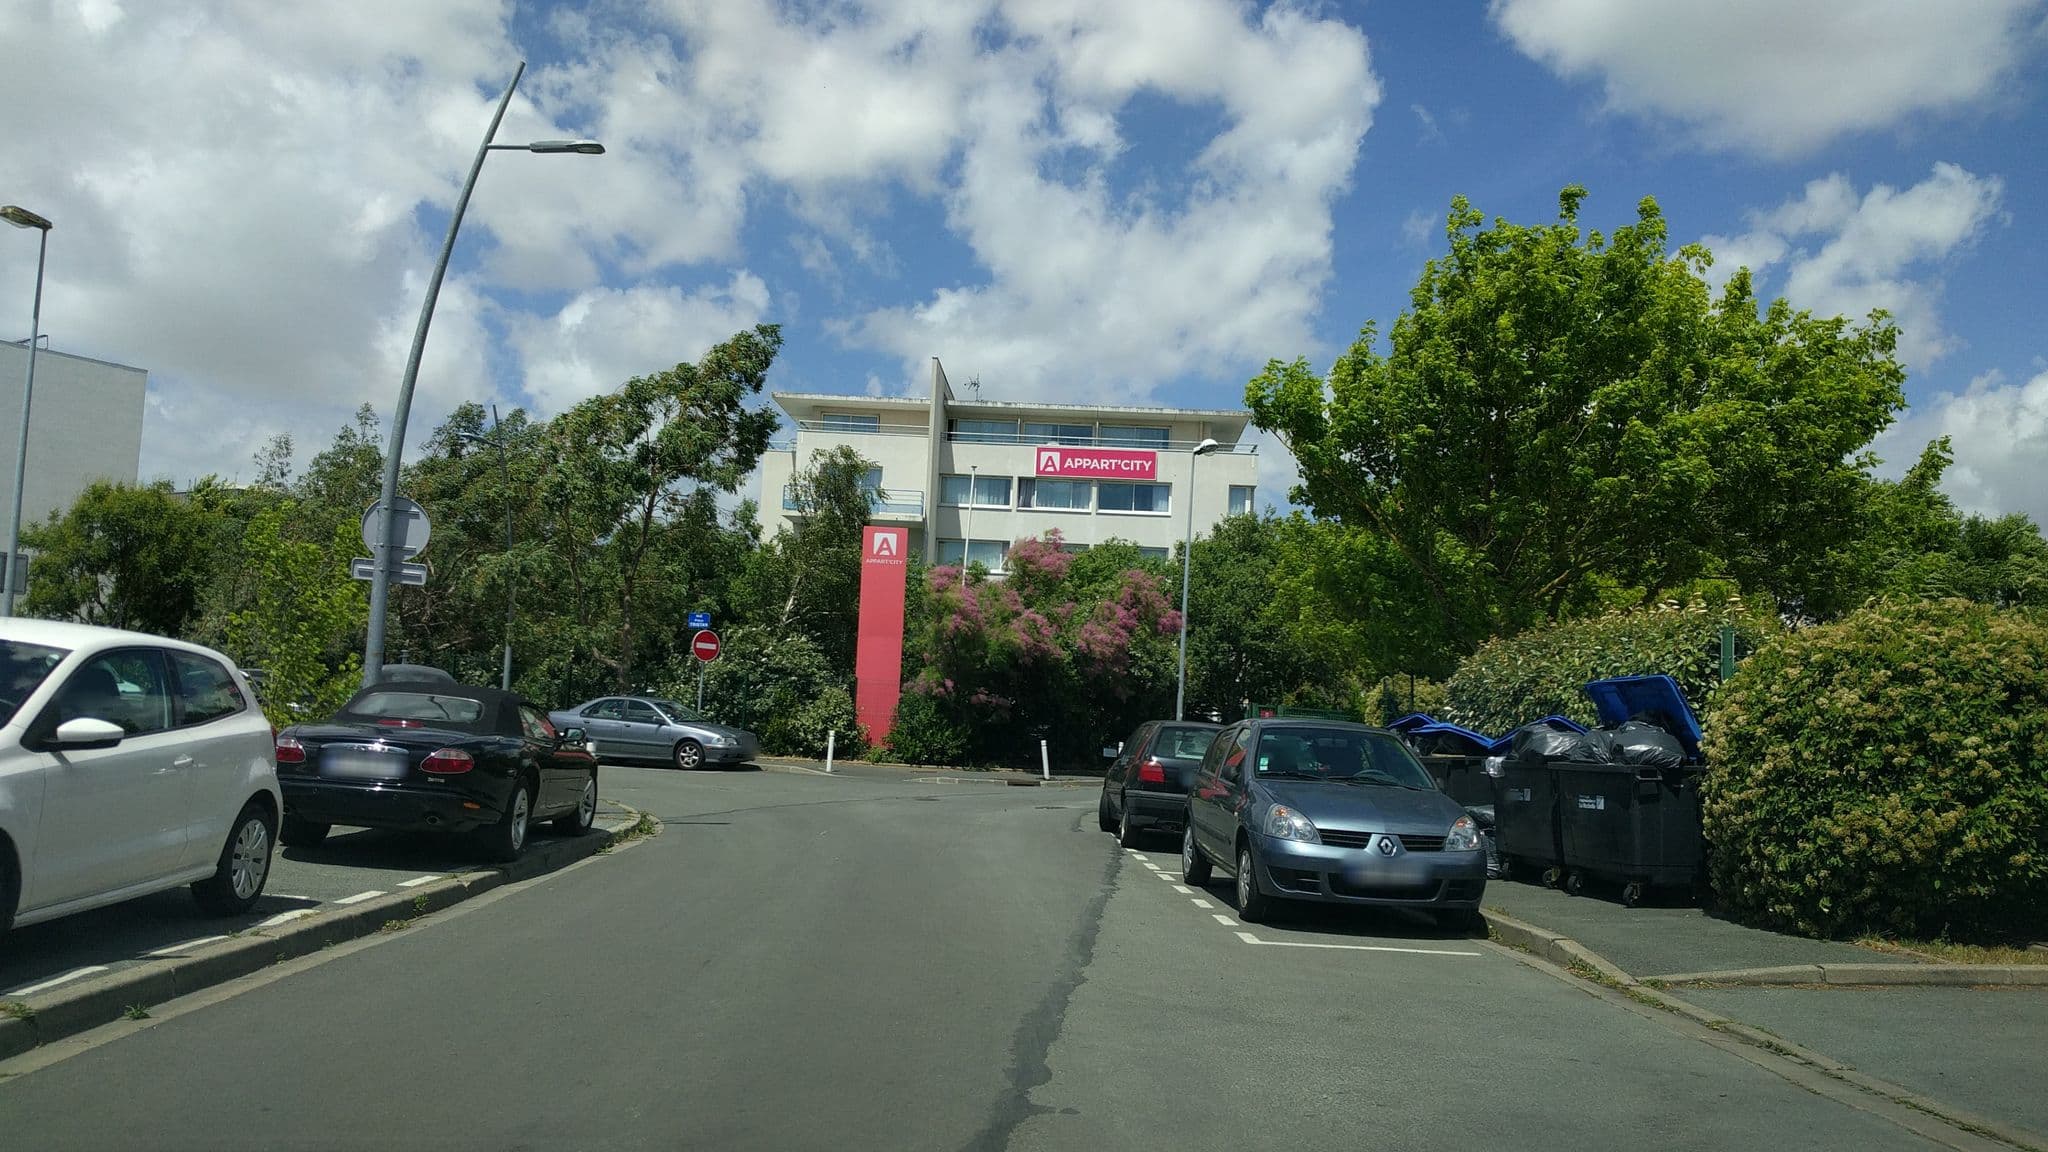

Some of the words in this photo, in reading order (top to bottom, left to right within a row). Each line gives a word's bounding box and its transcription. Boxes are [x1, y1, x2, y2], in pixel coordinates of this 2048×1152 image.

[1041, 455, 1059, 472] A
[1064, 458, 1152, 471] APPART'CITY
[875, 536, 895, 556] A
